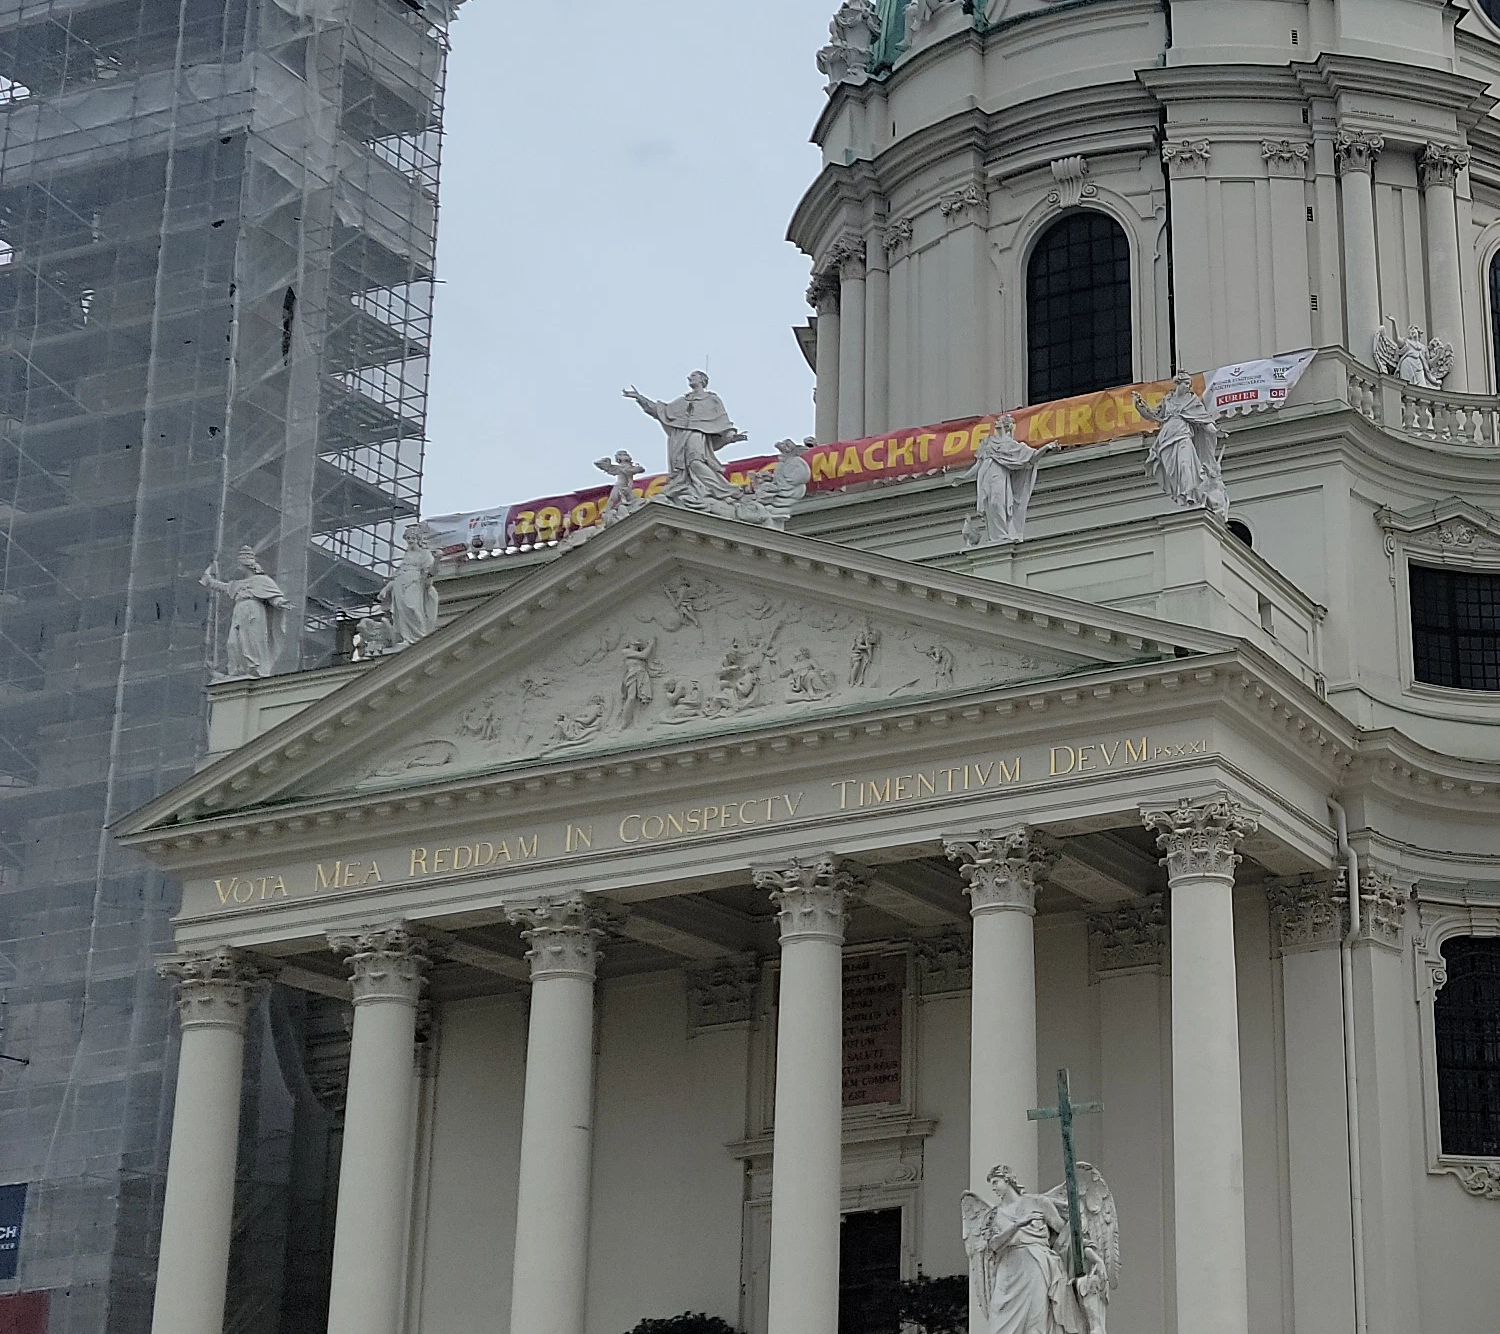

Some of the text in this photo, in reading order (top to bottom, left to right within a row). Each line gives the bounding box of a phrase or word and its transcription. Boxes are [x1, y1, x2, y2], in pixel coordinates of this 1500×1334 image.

[1218, 391, 1256, 405] KURIER
[812, 433, 936, 482] NACHT
[943, 423, 1016, 456] DE
